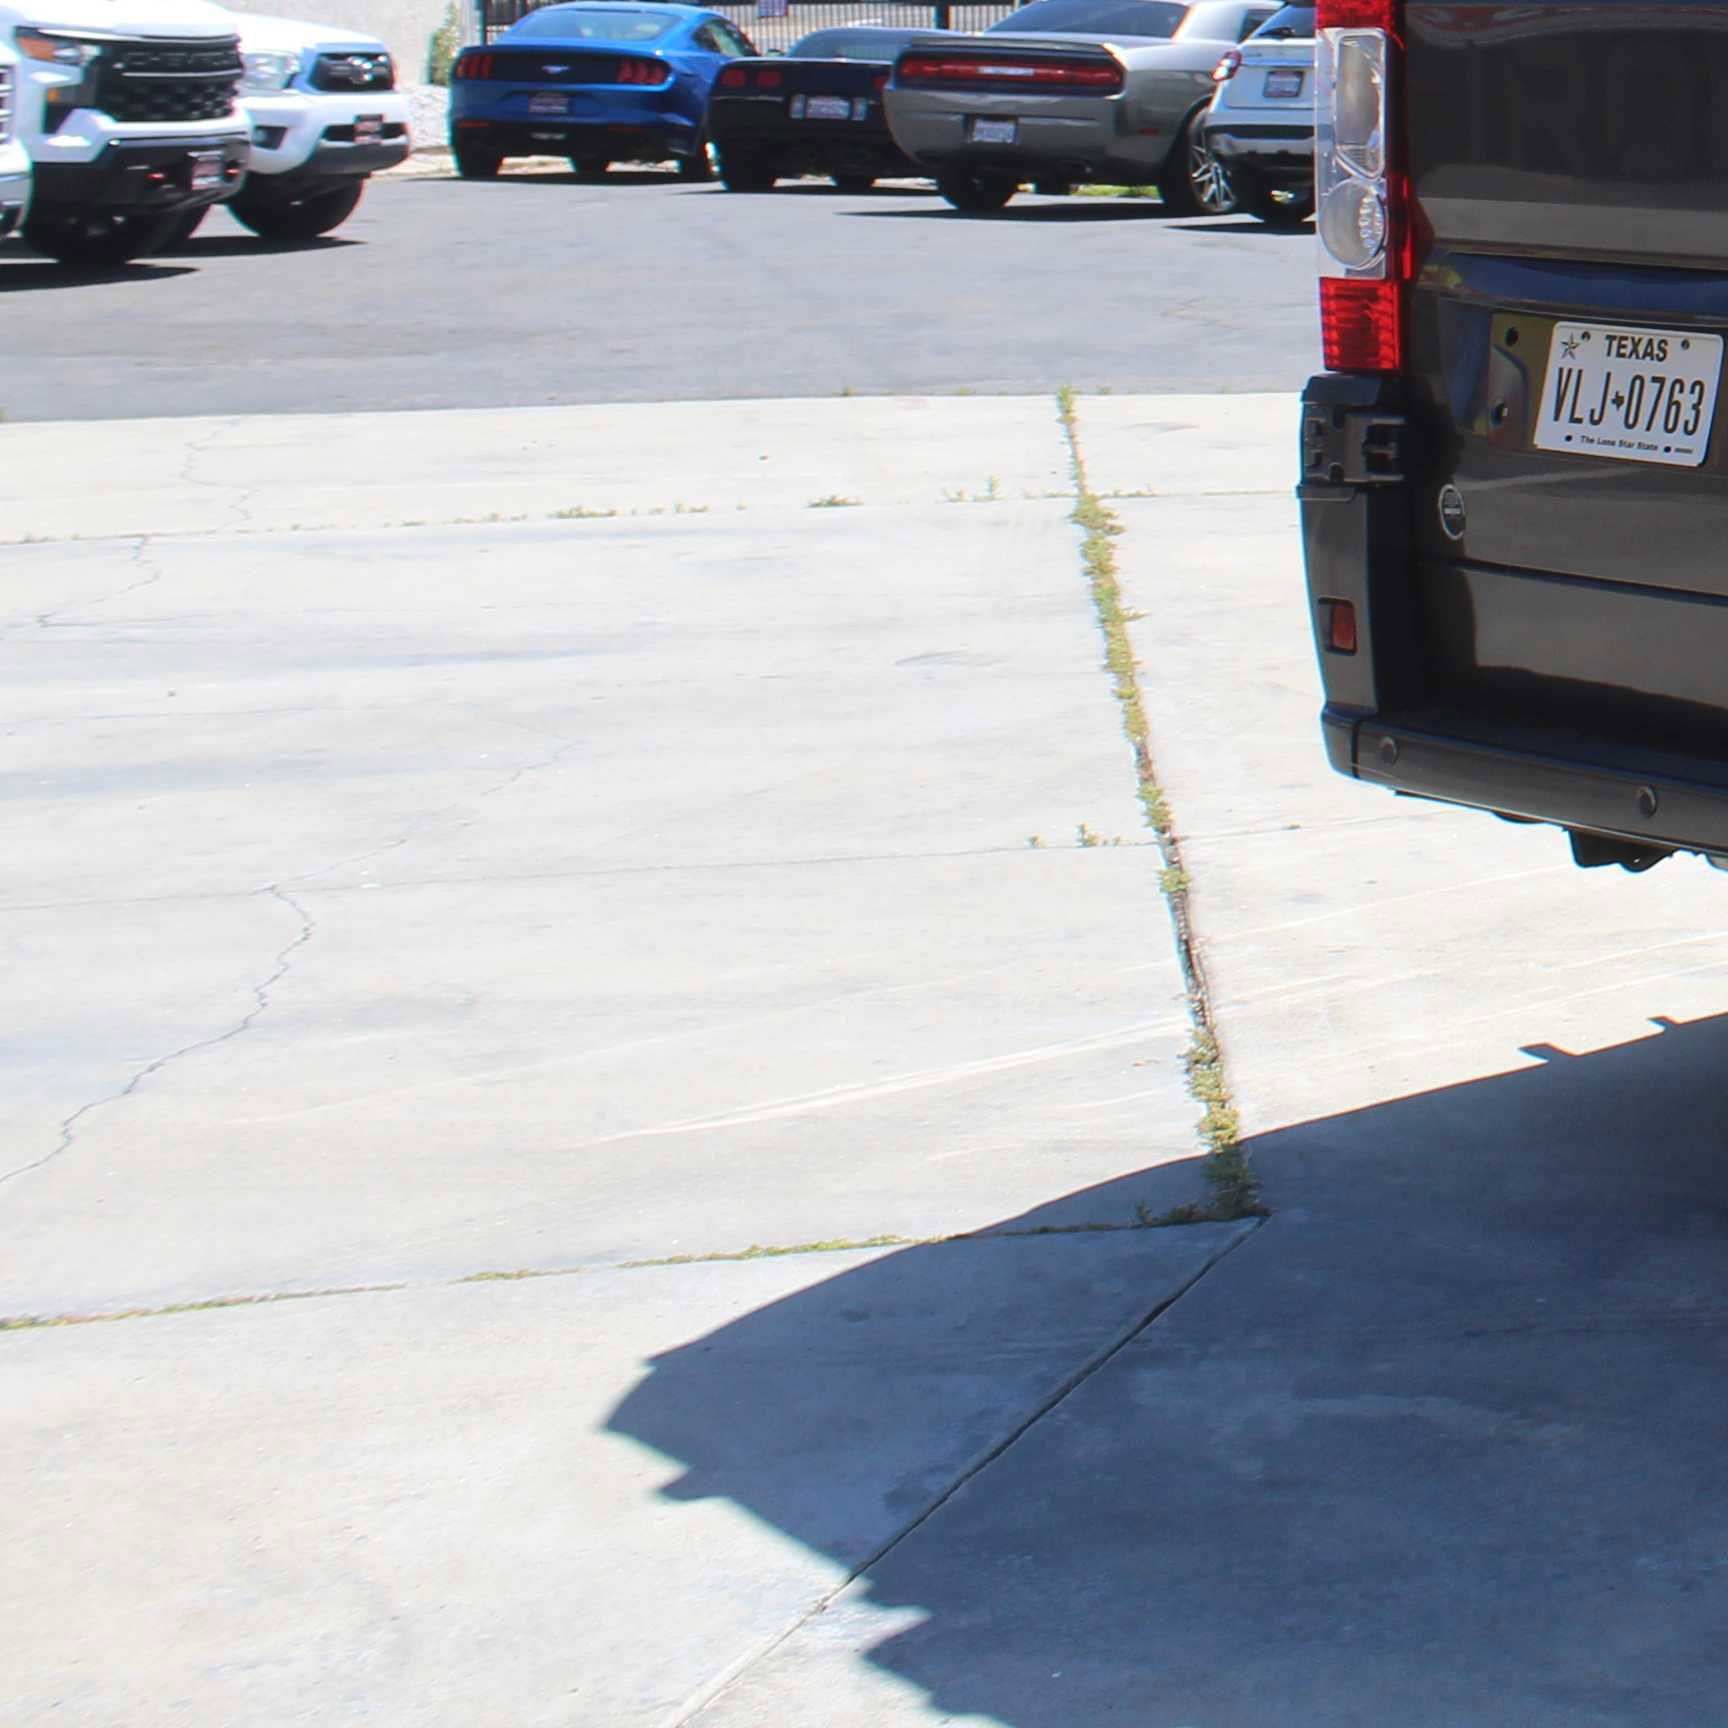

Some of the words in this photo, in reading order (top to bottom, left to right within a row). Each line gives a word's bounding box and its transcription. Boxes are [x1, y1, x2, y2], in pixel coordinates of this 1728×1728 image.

[1605, 334, 1669, 362] TEXAS
[1580, 434, 1595, 444] The
[1597, 436, 1616, 446] Lone
[1618, 438, 1635, 449] Star
[1636, 441, 1659, 451] State
